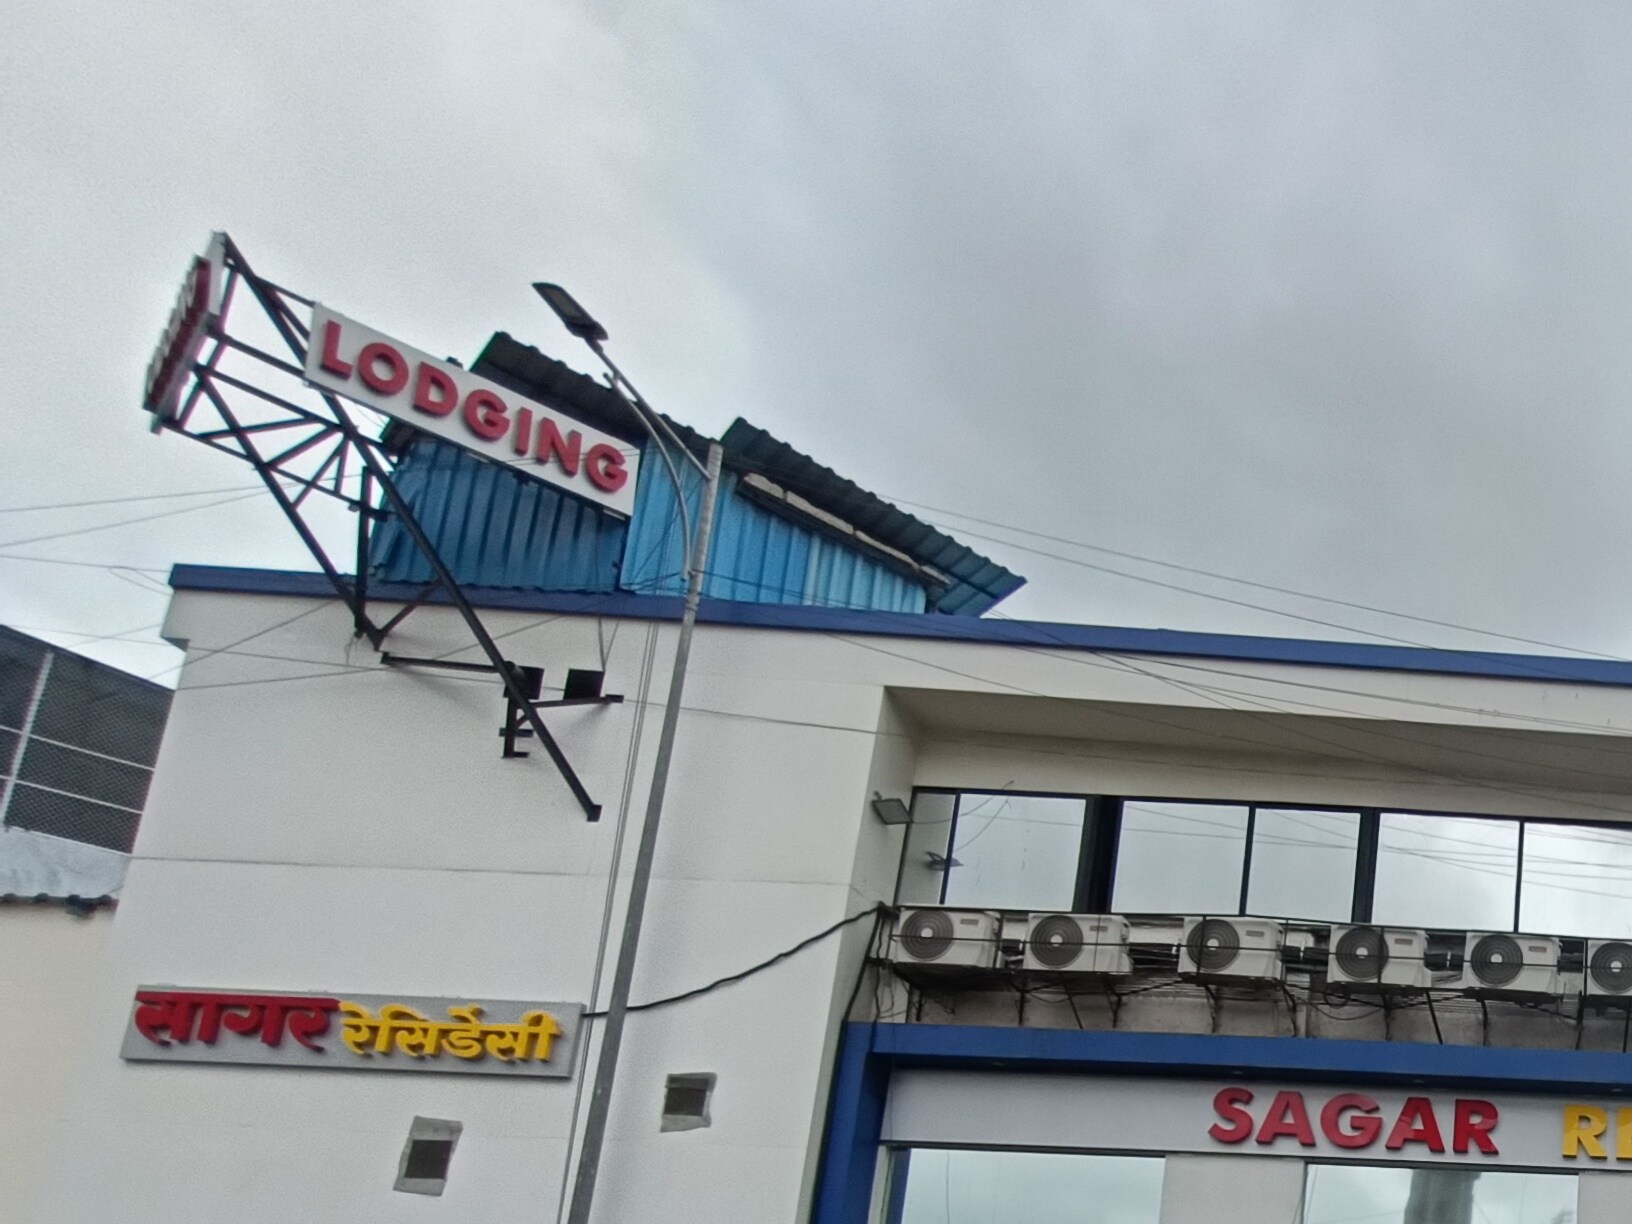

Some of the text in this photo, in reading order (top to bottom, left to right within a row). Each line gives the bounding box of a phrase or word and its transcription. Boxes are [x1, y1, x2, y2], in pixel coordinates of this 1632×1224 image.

[320, 319, 628, 493] LODGING
[135, 990, 340, 1052] सागर
[1207, 1086, 1500, 1155] SAGAR
